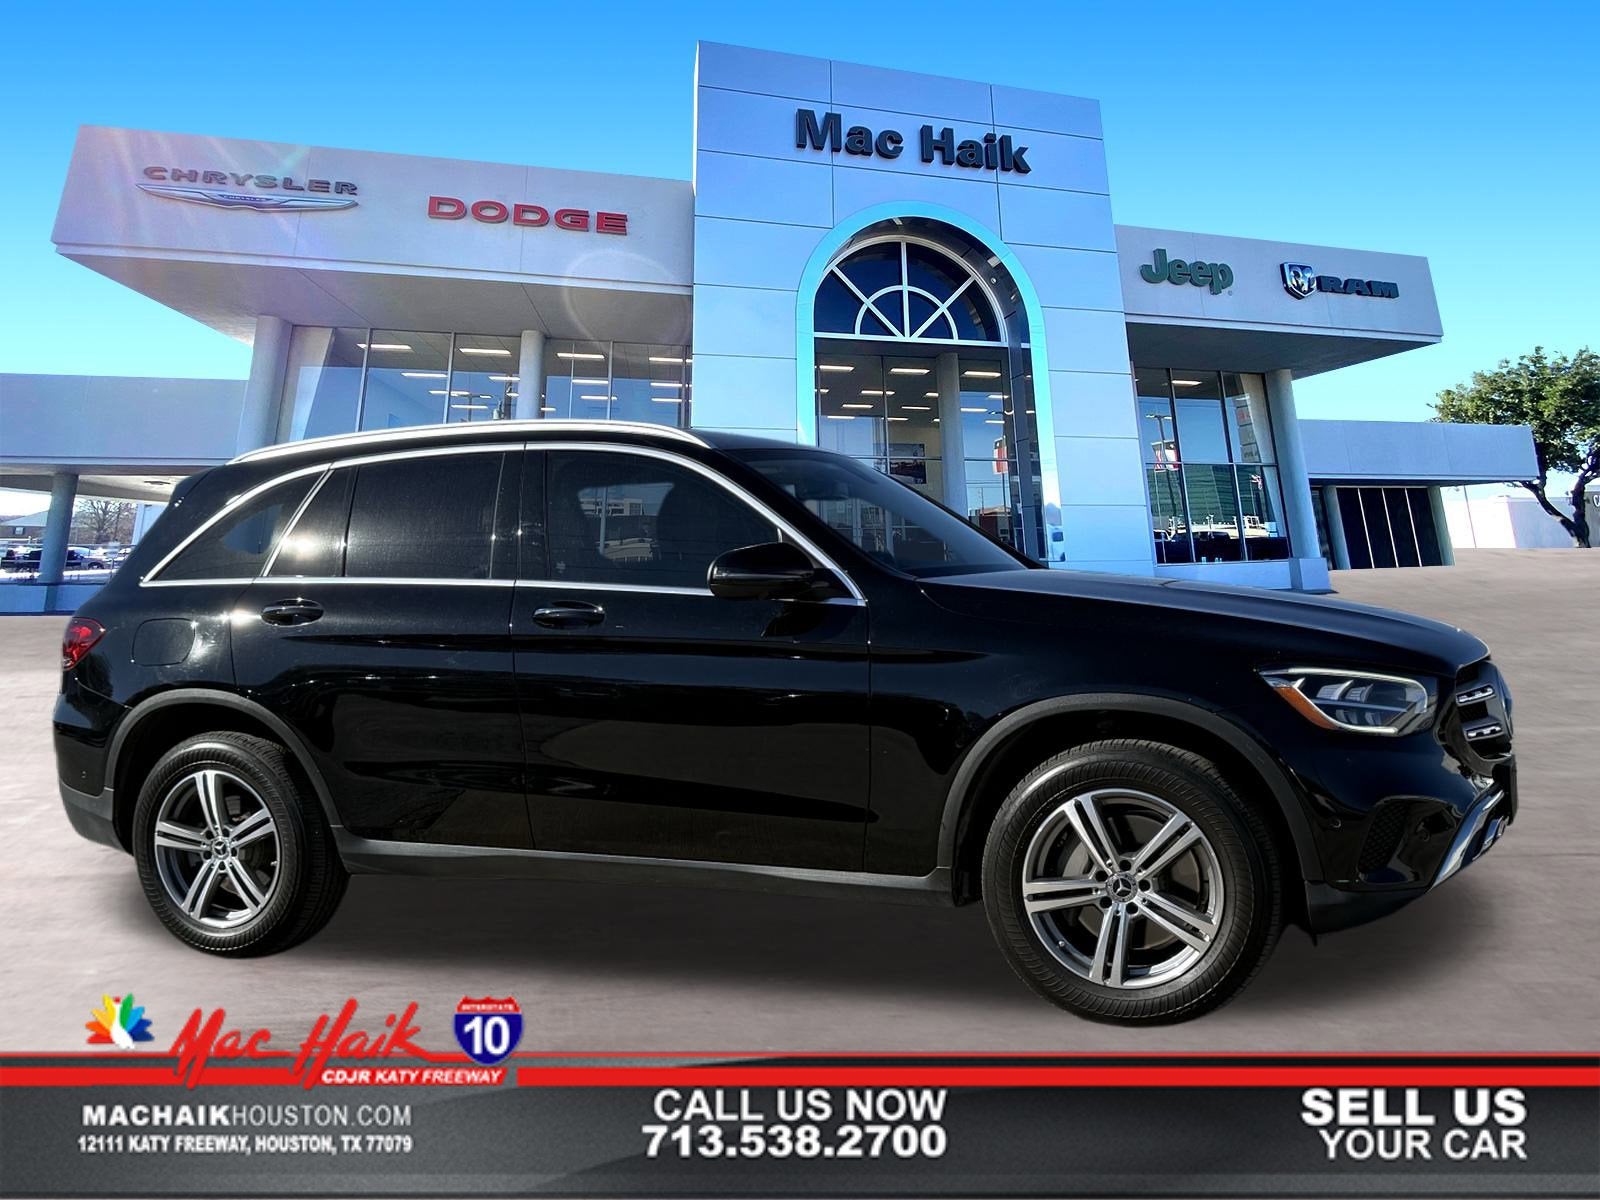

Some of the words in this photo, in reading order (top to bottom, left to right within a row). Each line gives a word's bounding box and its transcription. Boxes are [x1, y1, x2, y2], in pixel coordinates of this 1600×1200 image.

[796, 108, 904, 159] Mac
[920, 124, 1031, 174] Haik
[143, 166, 358, 196] CHRYSLER
[428, 196, 628, 236] DODGE
[1140, 248, 1234, 295] Jeep
[1316, 275, 1399, 299] RAM
